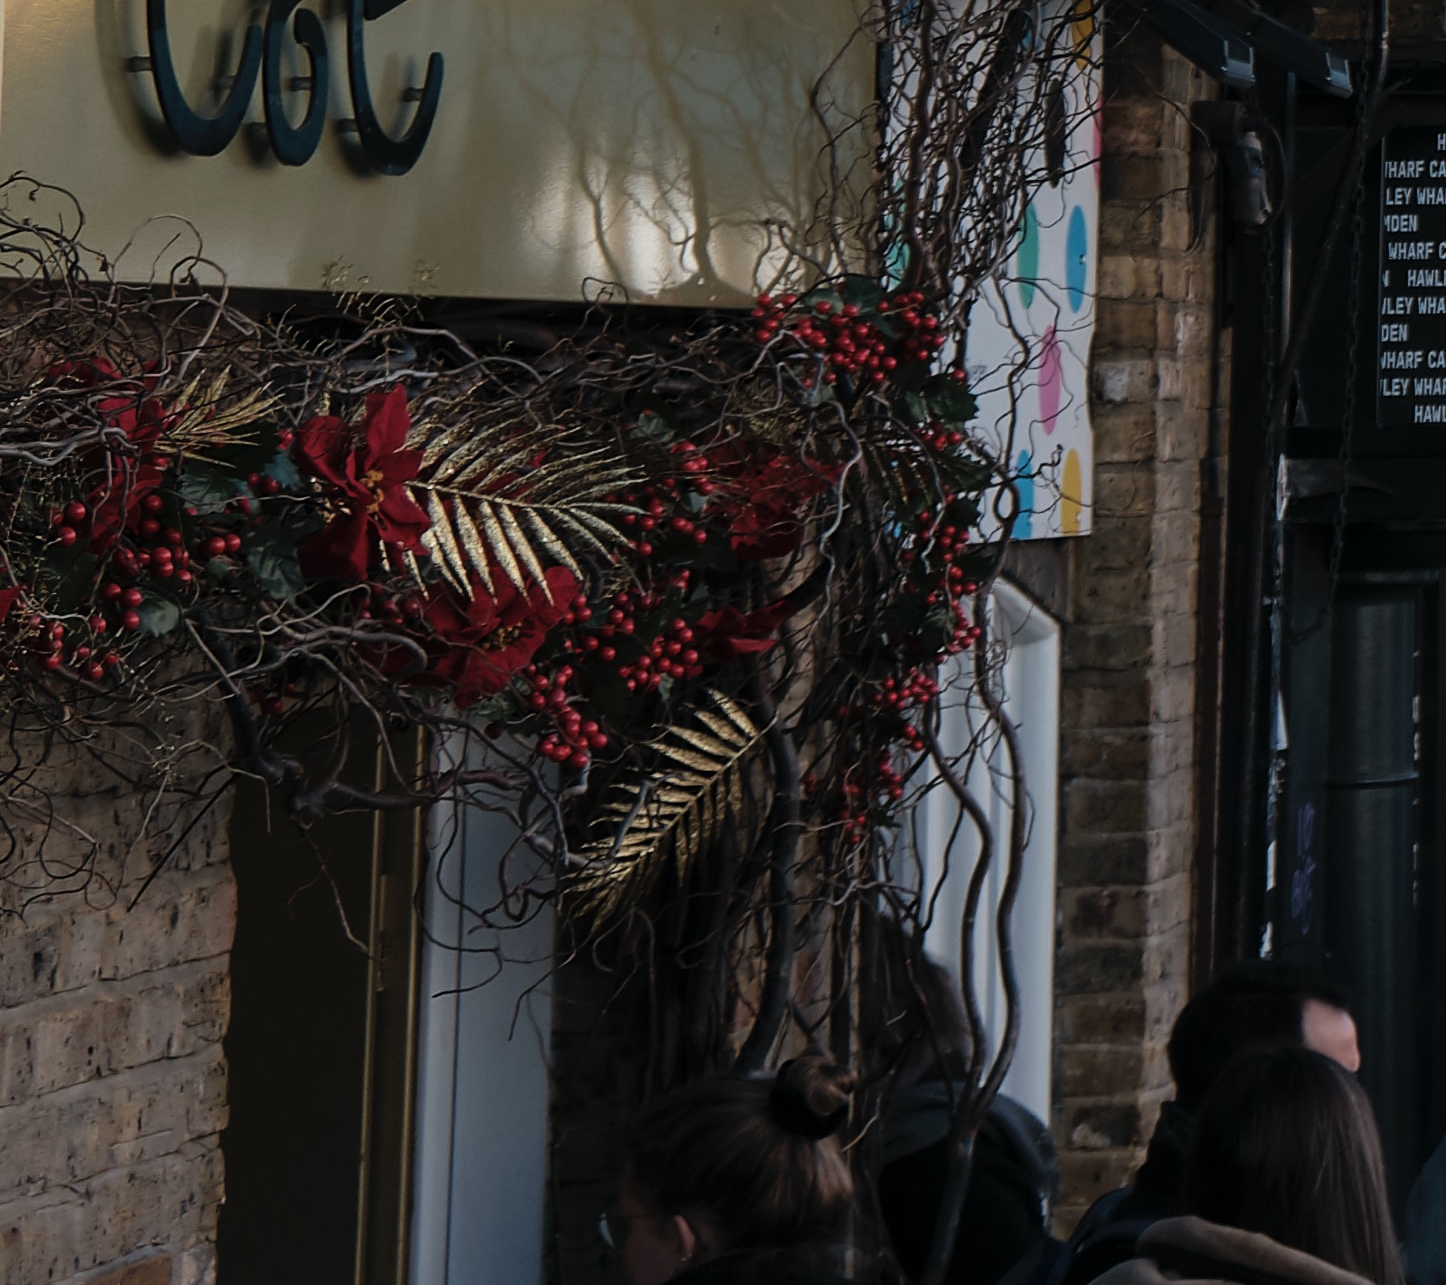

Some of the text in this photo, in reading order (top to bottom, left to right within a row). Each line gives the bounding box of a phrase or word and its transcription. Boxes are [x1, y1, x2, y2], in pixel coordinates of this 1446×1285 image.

[1389, 242, 1433, 259] WHARF
[1382, 297, 1413, 314] LEY
[1380, 379, 1409, 396] LEY
